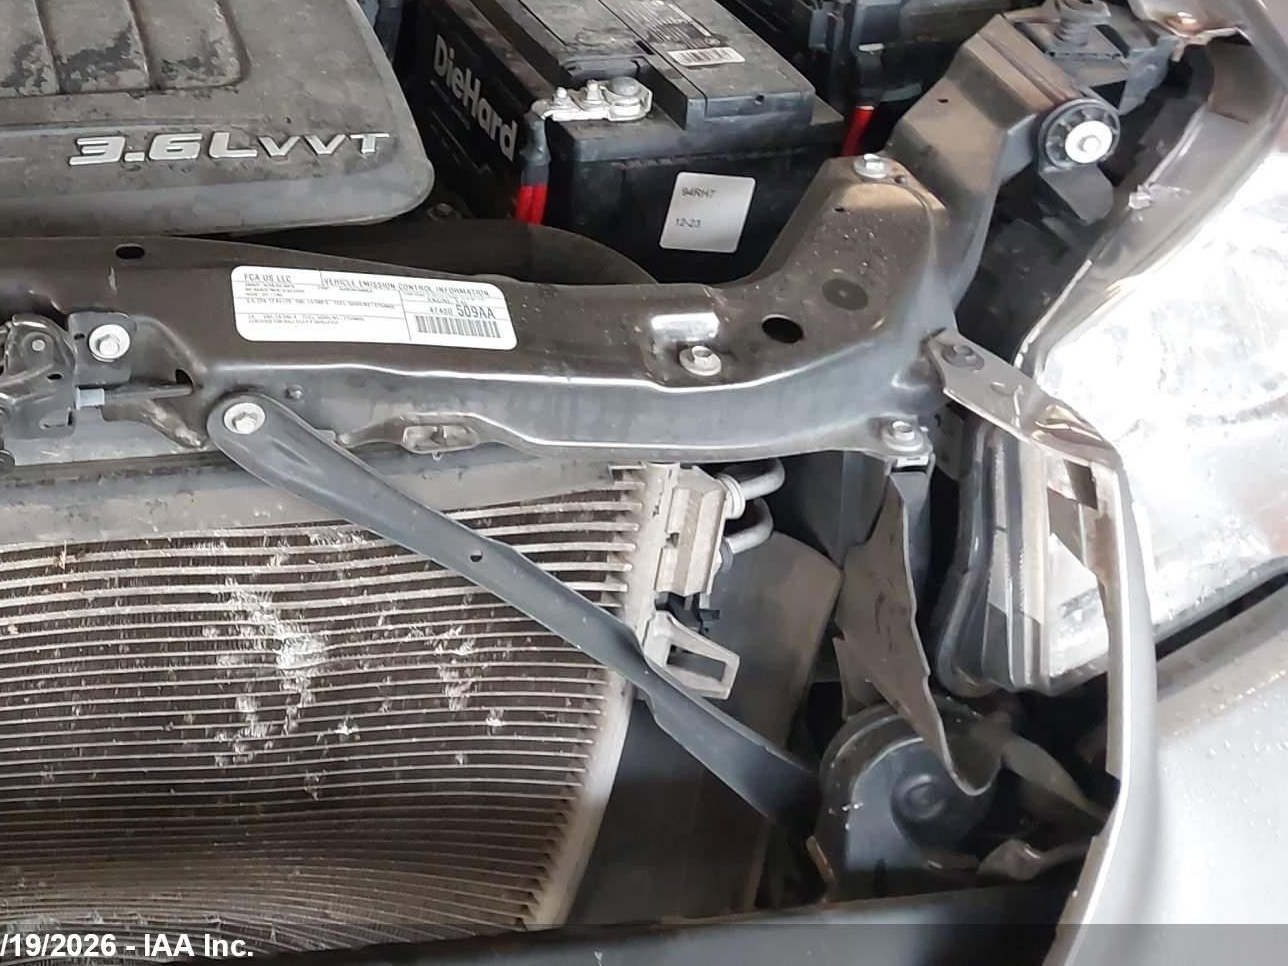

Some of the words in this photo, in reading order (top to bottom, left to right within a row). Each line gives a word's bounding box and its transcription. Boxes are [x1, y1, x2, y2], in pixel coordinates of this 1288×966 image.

[433, 34, 518, 163] DieHard
[68, 132, 258, 166] 3.6L
[258, 133, 390, 157] VVT
[244, 273, 260, 283] FCA
[262, 274, 274, 283] US
[276, 274, 292, 283] LLC
[324, 277, 357, 287] VEHICLE
[358, 279, 396, 290] EMISSION
[398, 283, 433, 292] CONTROL
[436, 286, 489, 297] INFORMATION
[456, 304, 496, 320] 509AA
